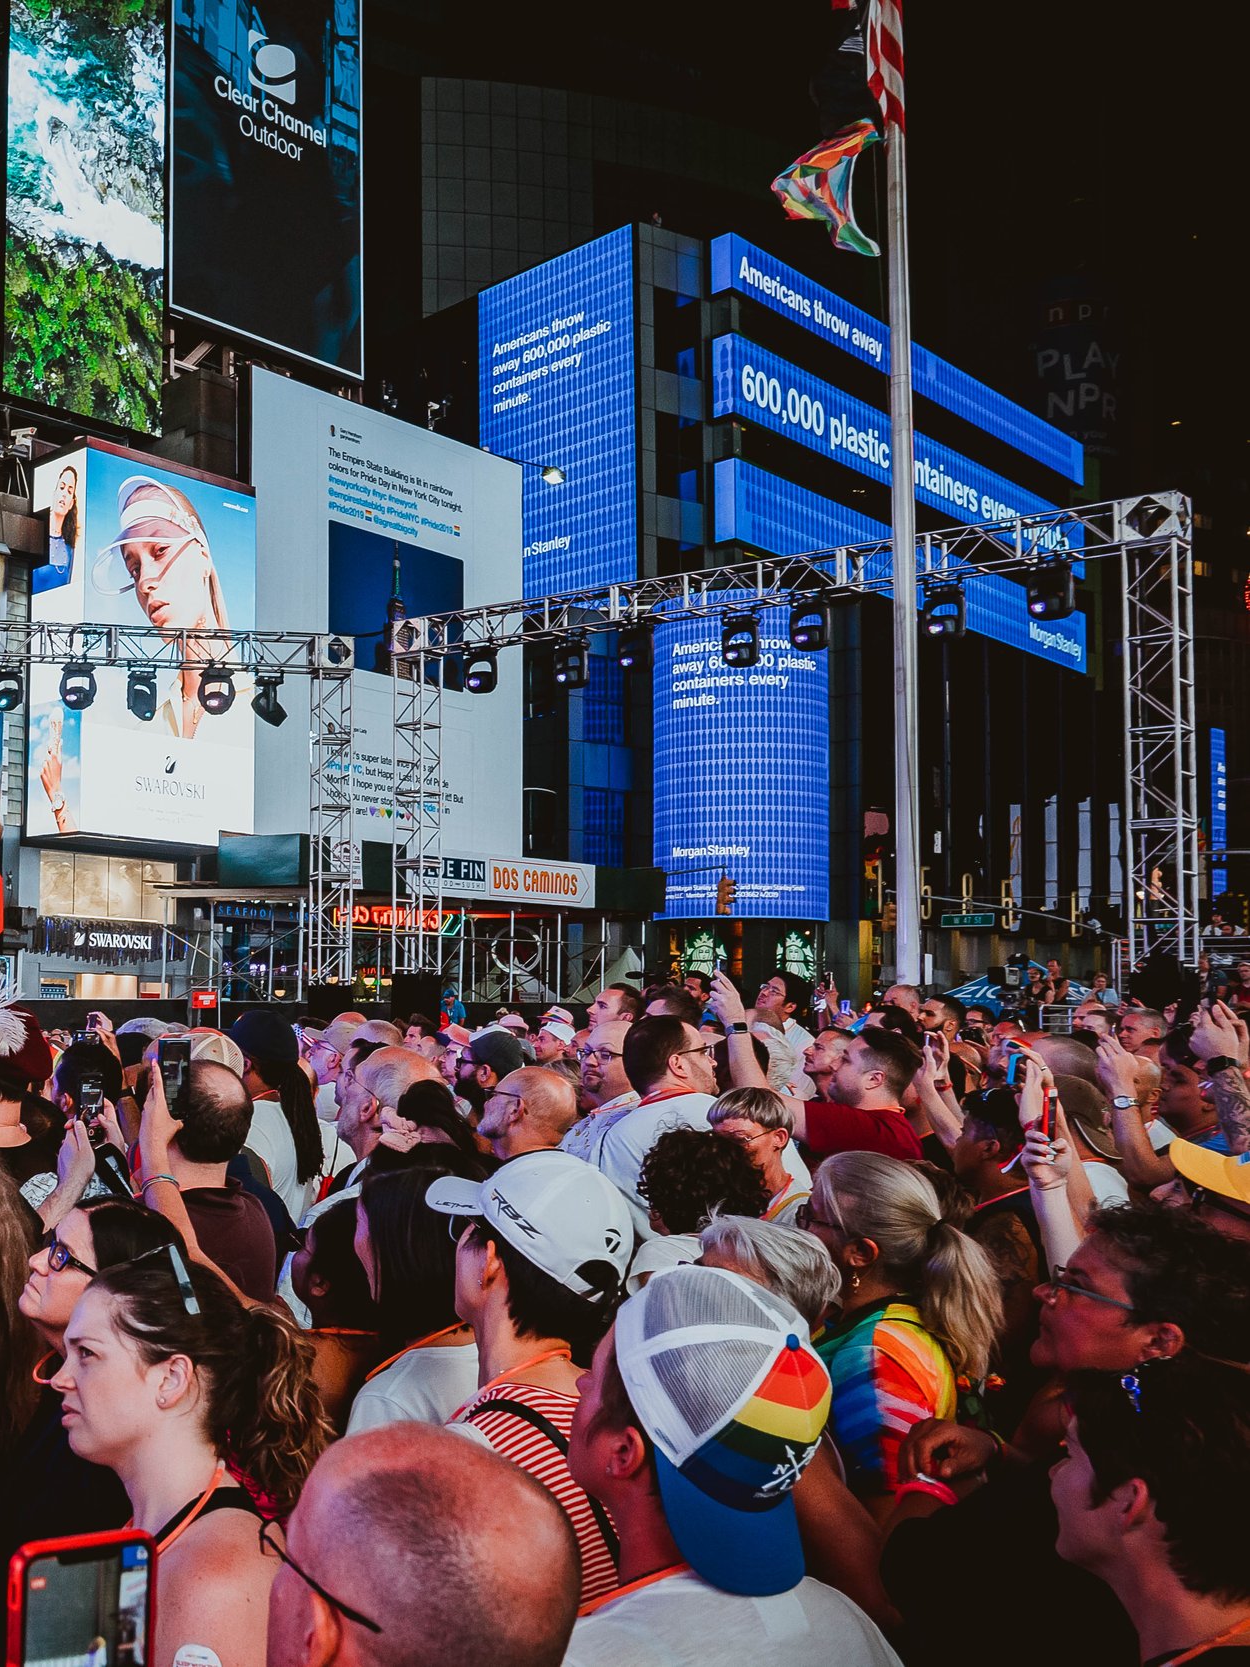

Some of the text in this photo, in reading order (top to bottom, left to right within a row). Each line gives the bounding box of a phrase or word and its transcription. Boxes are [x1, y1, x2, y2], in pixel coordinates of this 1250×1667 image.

[214, 75, 327, 148] Clear Channel
[239, 114, 303, 162] Outdoor
[739, 256, 883, 362] Americans throw away
[492, 310, 585, 359] Americans throw
[492, 319, 611, 378] away 600,000 plastic
[492, 352, 582, 396] containers every
[492, 391, 532, 415] minute.
[741, 365, 978, 513] 600,000 plastic ntainers
[328, 447, 341, 458] The
[342, 452, 365, 467] Empire
[366, 460, 383, 473] State
[384, 466, 408, 484] Building
[409, 475, 415, 484] is
[423, 479, 428, 488] in
[429, 483, 453, 497] rainbow
[328, 462, 462, 513] colors for Pride Day in New York City tonight.
[328, 474, 418, 510] #newyorkcity #nyc #newyork
[328, 501, 364, 519] #Pride2019
[387, 506, 420, 524] #PrideNYC
[421, 518, 453, 535] #Pride2019
[672, 655, 817, 676] away plastic
[672, 673, 789, 692] containers every
[672, 693, 720, 710] minute.
[361, 754, 392, 765] super late
[365, 767, 376, 776] but
[135, 776, 205, 800] SWAROVSKI
[356, 778, 373, 789] hope
[374, 783, 386, 792] you
[453, 795, 464, 804] But
[361, 795, 379, 804] never
[355, 807, 368, 816] are!
[672, 845, 750, 859] Morgan Stanley
[461, 861, 484, 880] FIN
[493, 866, 578, 896] DOS CAMINOS
[88, 933, 152, 950] SWAROVSKI
[491, 1188, 542, 1239] RBZ
